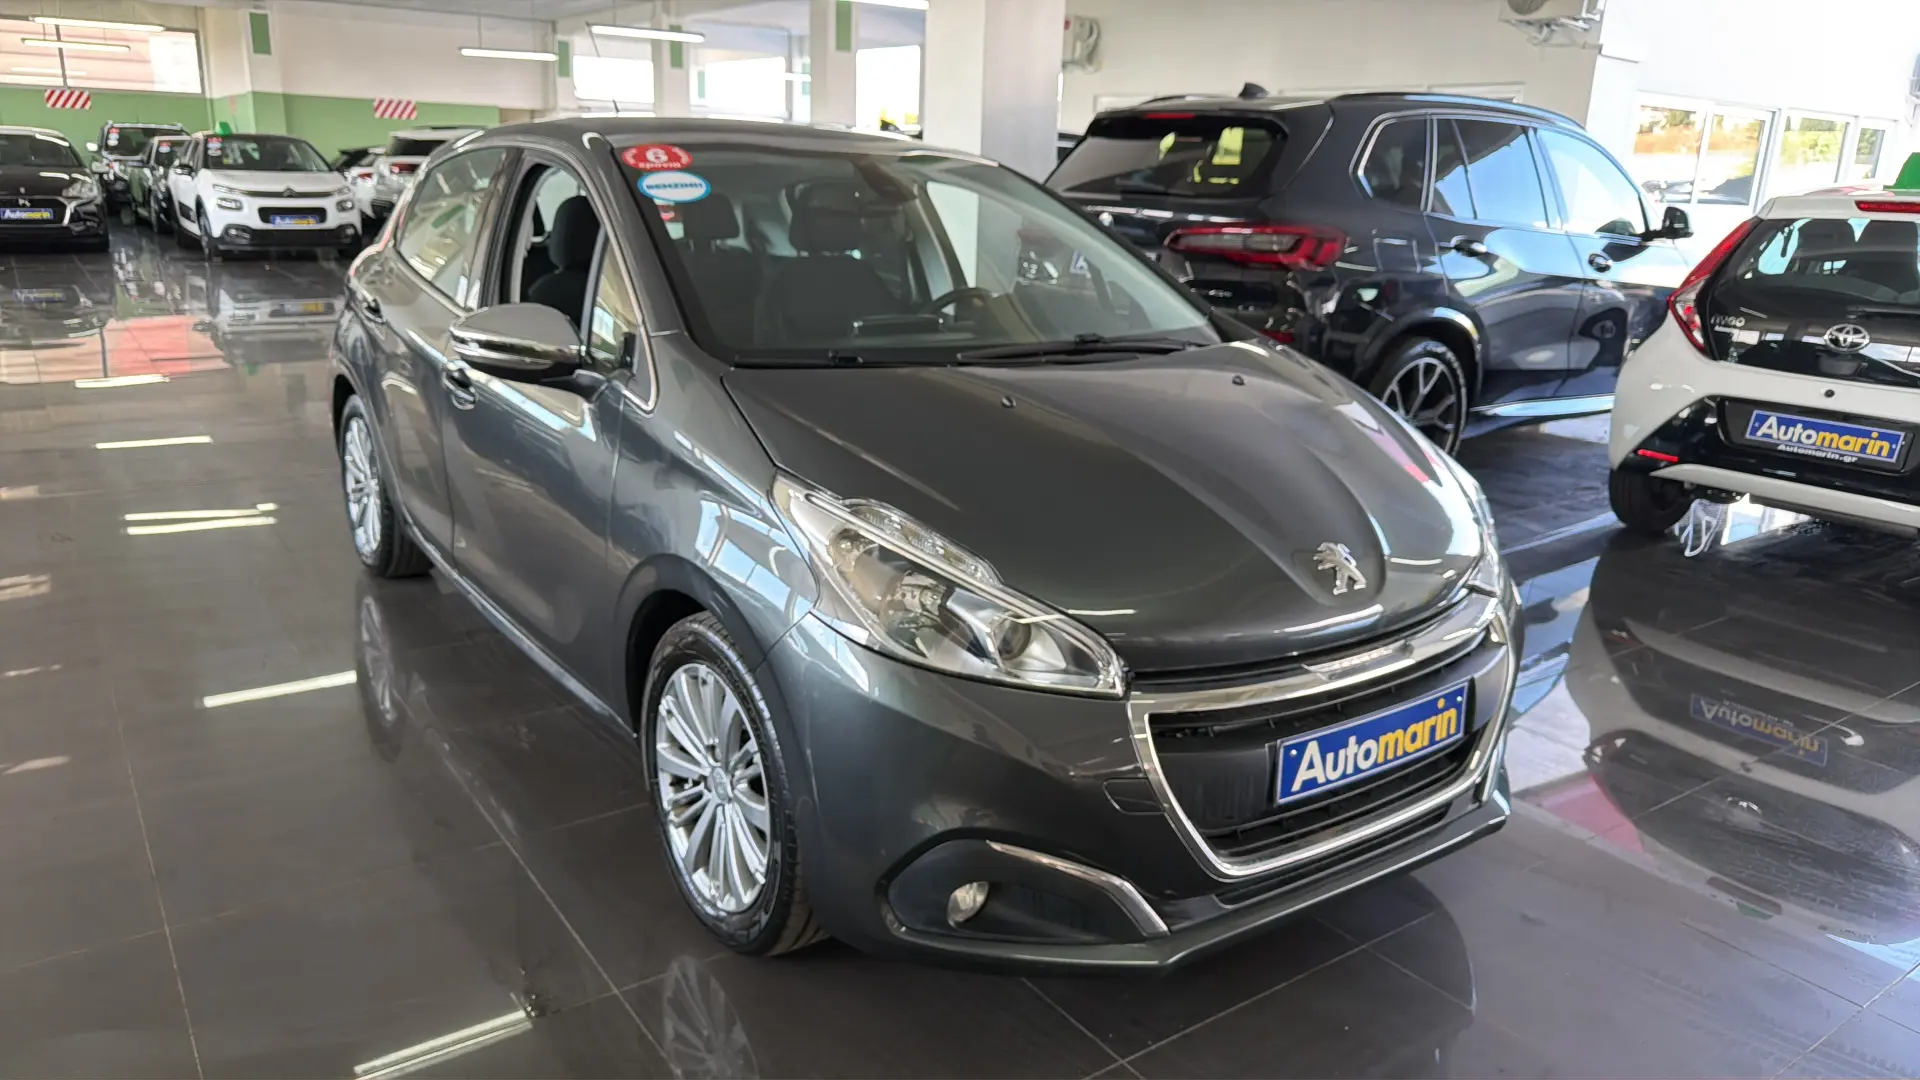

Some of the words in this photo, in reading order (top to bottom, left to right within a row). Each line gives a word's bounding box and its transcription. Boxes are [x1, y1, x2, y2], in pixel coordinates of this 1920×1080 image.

[645, 148, 669, 163] 6
[1756, 416, 1890, 457] Automarin
[1777, 443, 1858, 463] Automarin.gr
[1291, 697, 1457, 792] Automarin
